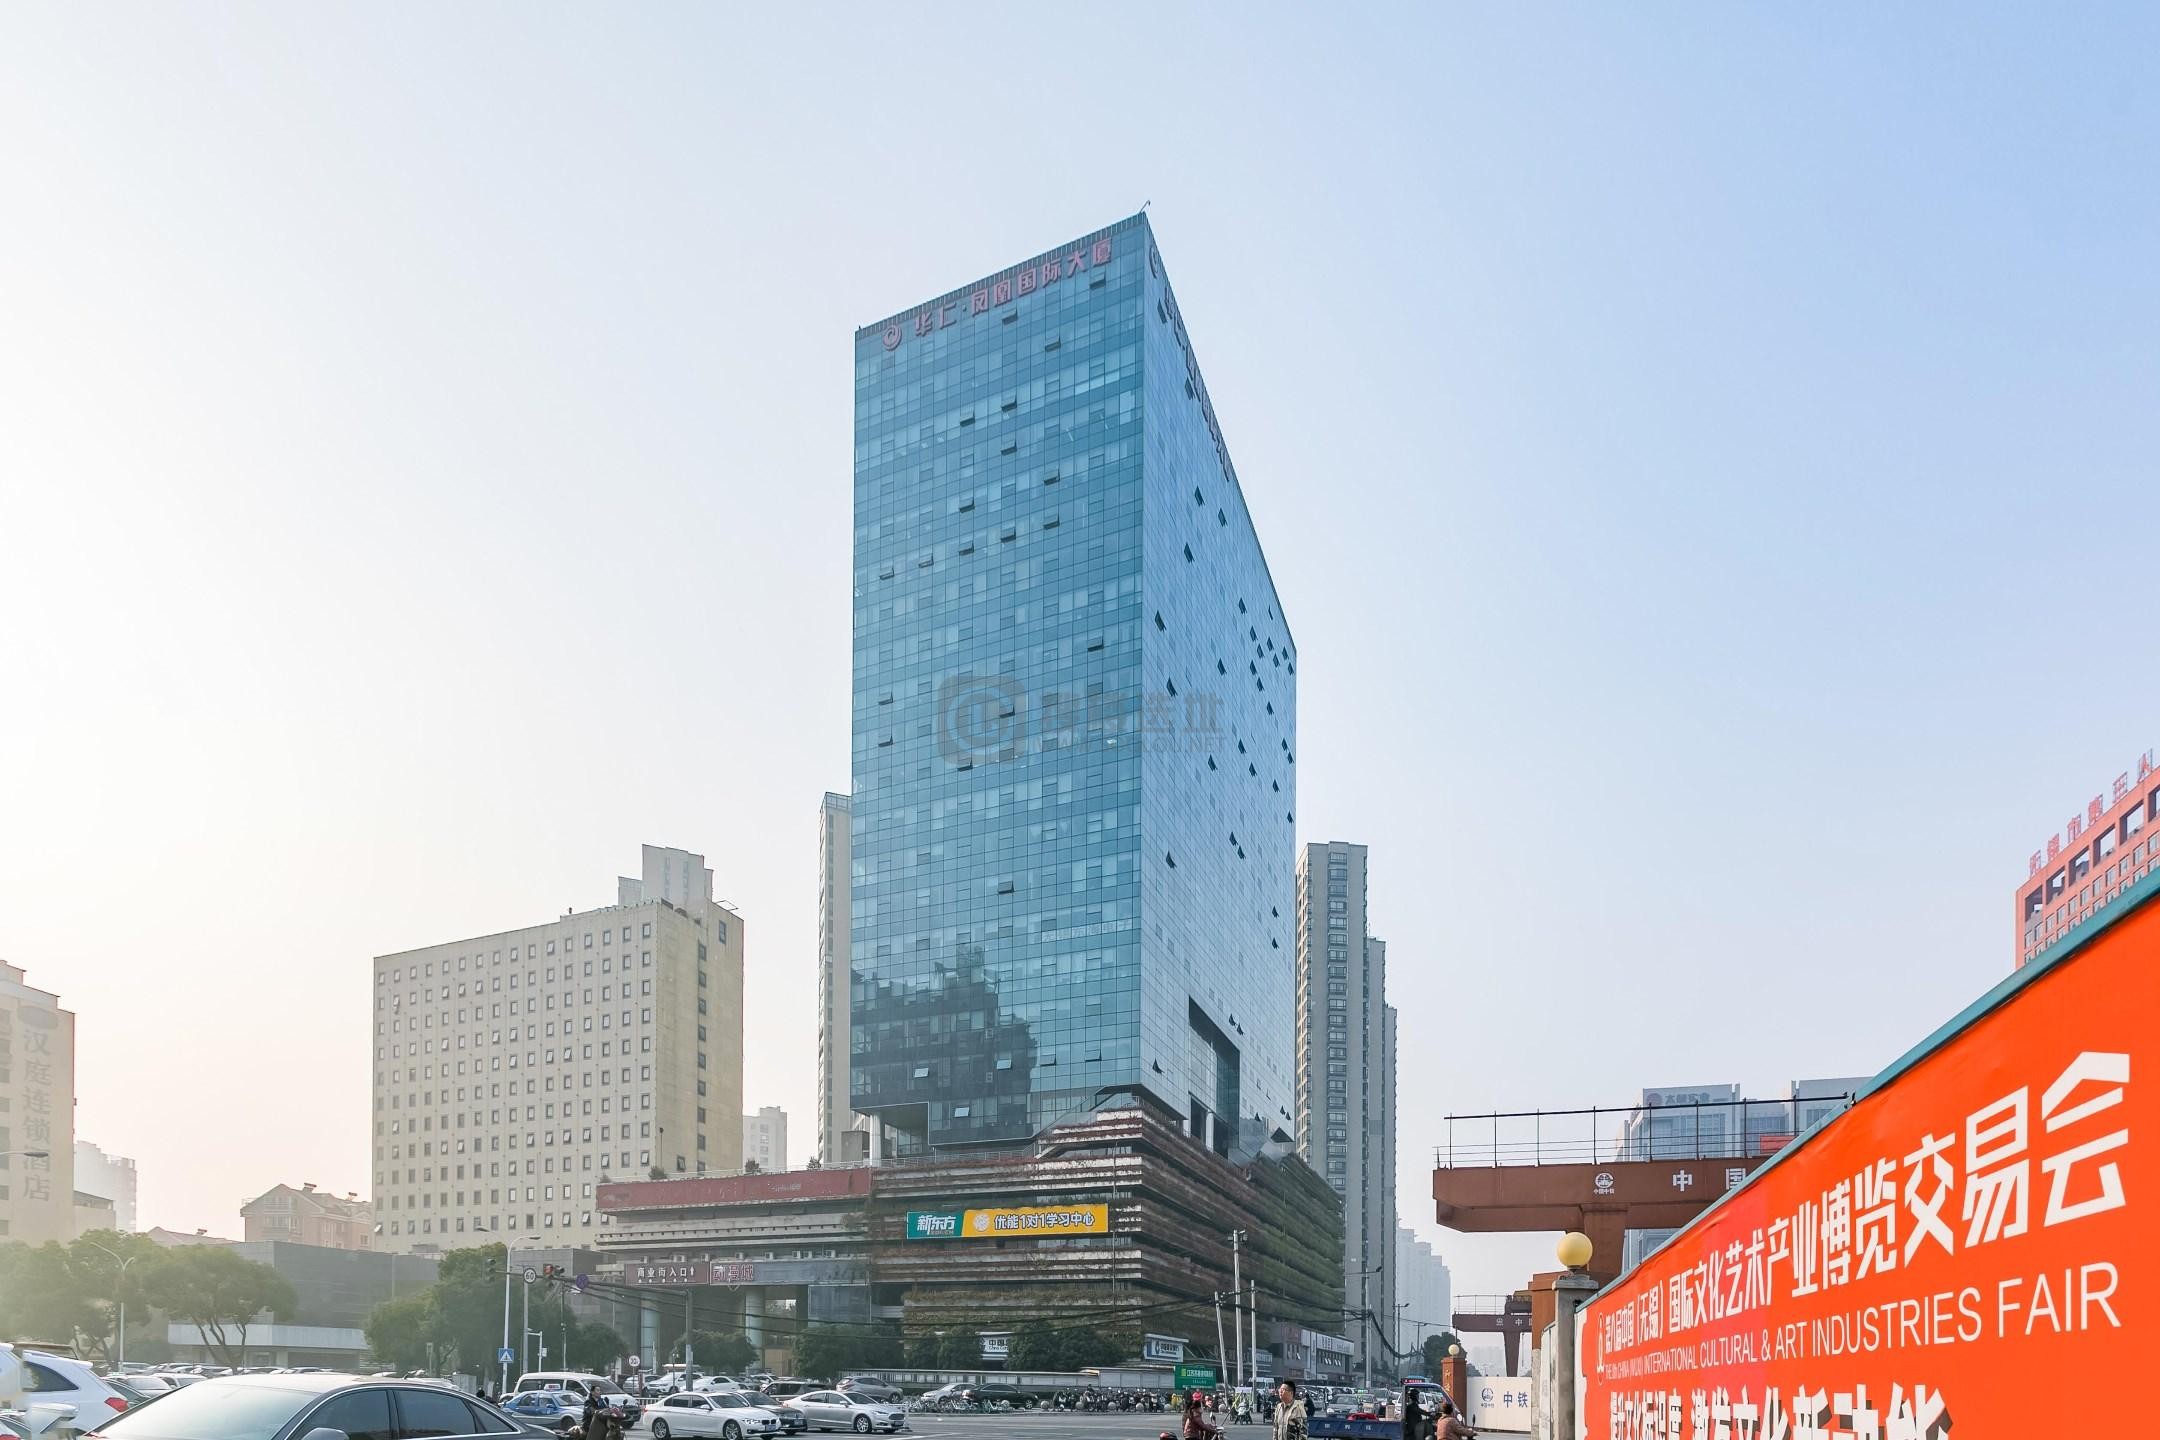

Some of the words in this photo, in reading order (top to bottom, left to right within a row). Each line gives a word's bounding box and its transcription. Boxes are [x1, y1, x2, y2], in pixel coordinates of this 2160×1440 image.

[24, 1029, 51, 1201] 汉庭连锁酒店
[917, 1214, 956, 1235] 新东方
[994, 1212, 1095, 1230] 优能1对1学习中心
[525, 1272, 535, 1281] 60
[637, 1267, 687, 1278] 商业街入口
[1644, 1345, 1698, 1375] INTERNATIONAL
[1700, 1332, 1758, 1368] CULTURAL
[1761, 1328, 1771, 1362] &
[1775, 1322, 1807, 1360] ART
[1812, 1287, 1982, 1357] INDUSTRIES
[1998, 1262, 2122, 1338] FAIR
[1503, 1390, 1528, 1409] 中铁
